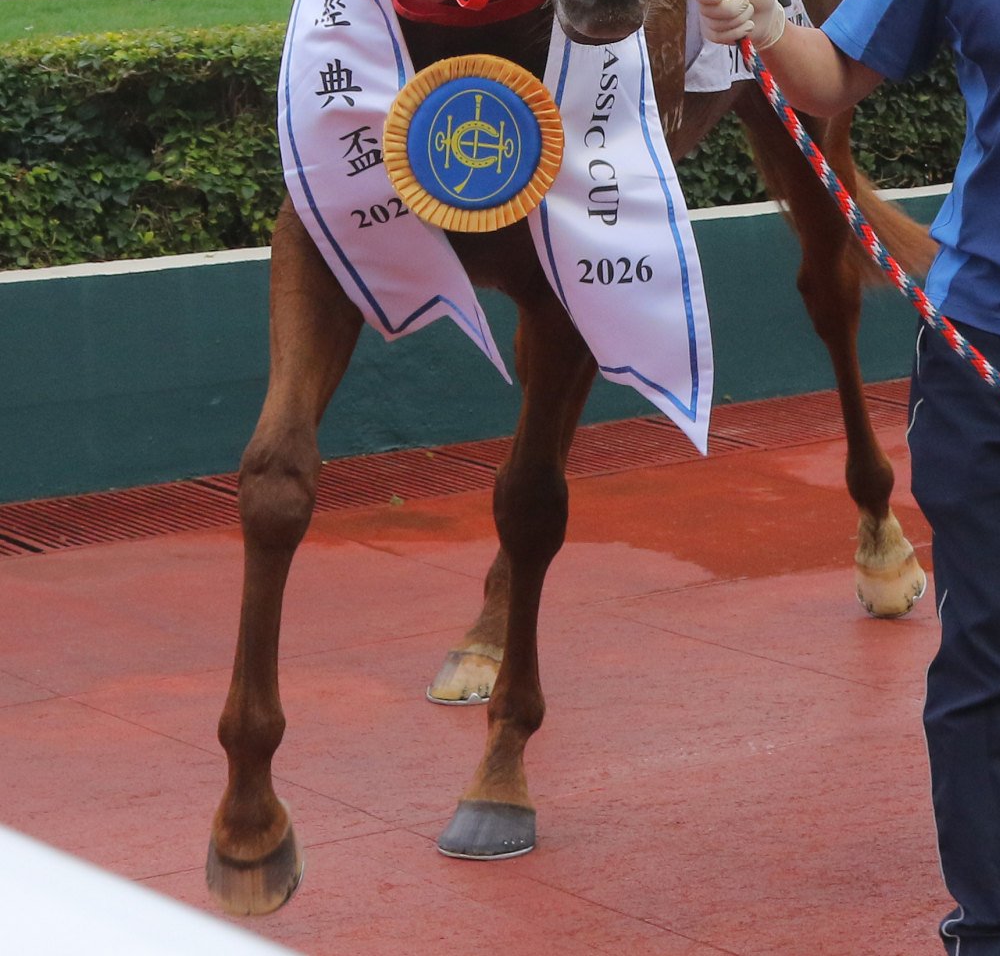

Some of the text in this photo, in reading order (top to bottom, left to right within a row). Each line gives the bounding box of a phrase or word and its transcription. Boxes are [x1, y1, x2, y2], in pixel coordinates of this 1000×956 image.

[584, 45, 619, 226] ASSIC CUP
[350, 197, 409, 228] 202
[577, 255, 653, 285] 2026
